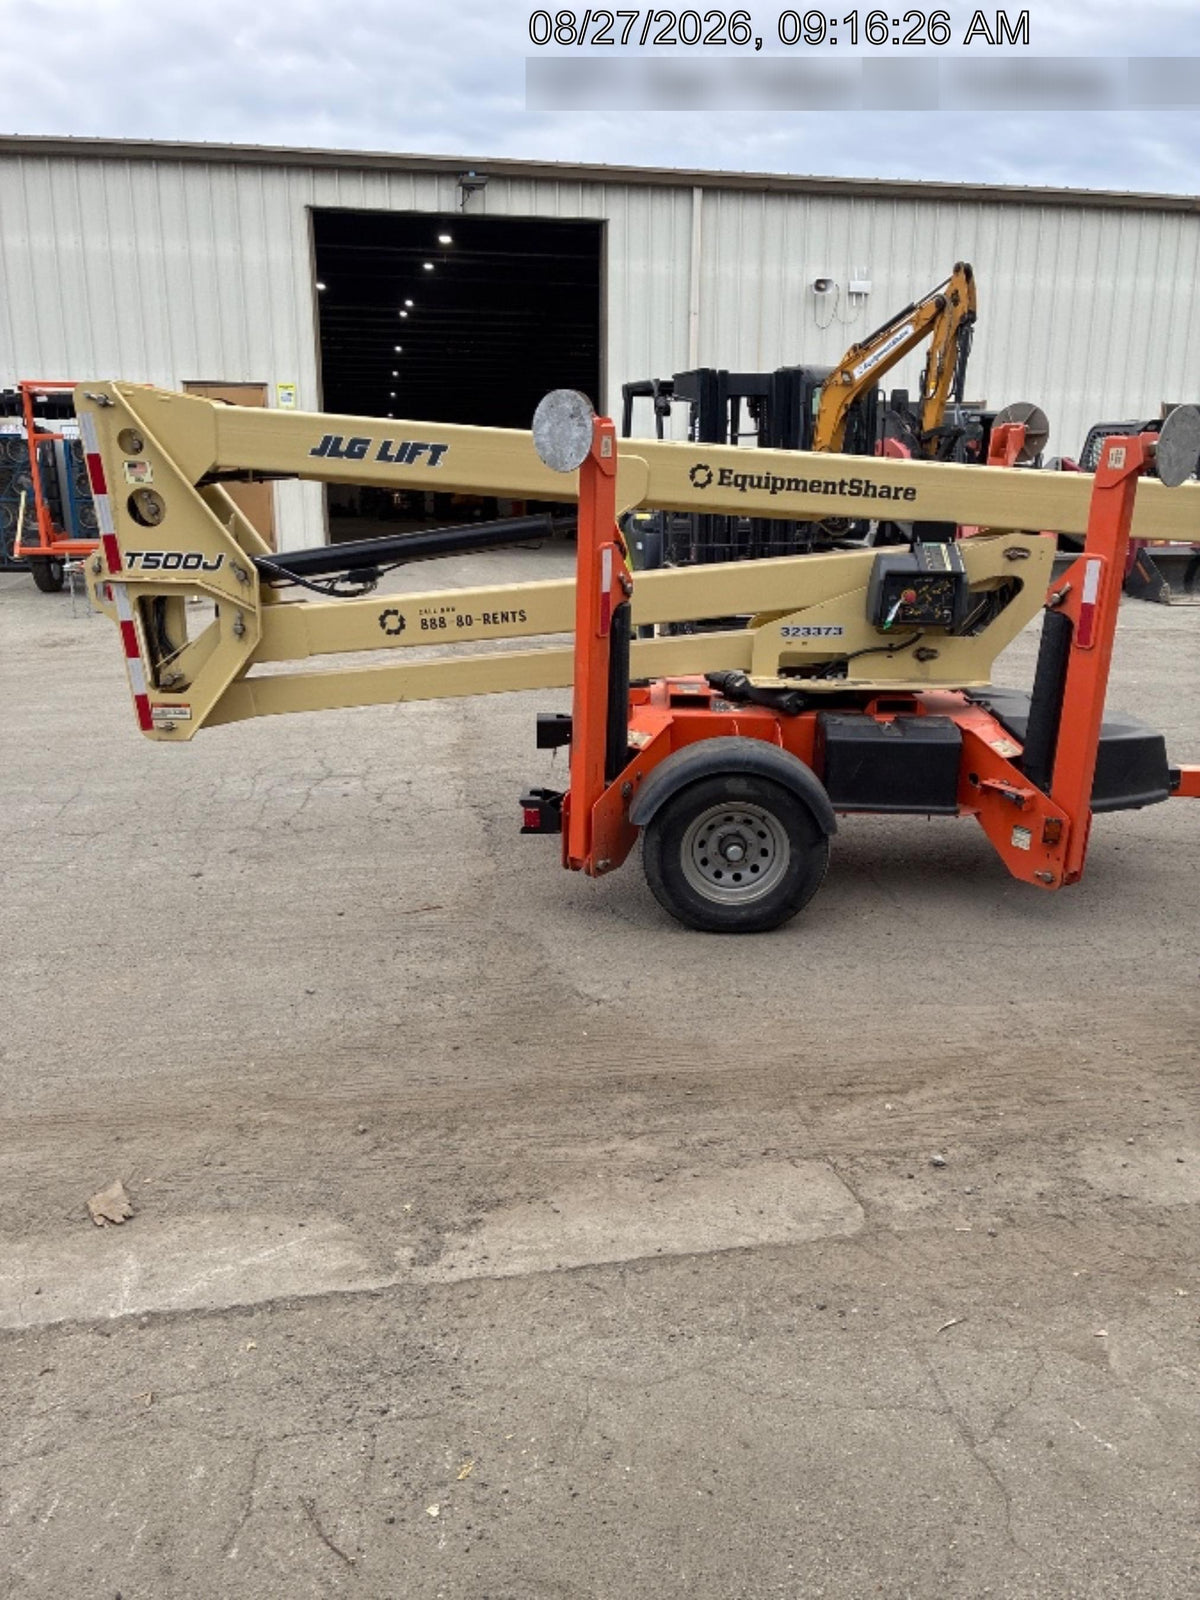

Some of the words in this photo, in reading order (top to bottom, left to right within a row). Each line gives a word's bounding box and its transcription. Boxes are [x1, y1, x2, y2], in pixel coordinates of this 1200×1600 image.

[308, 434, 373, 460] JLG
[375, 440, 450, 466] LIFT
[717, 468, 918, 500] EquipmentShare
[125, 552, 225, 571] T500J
[780, 626, 843, 637] 323373
